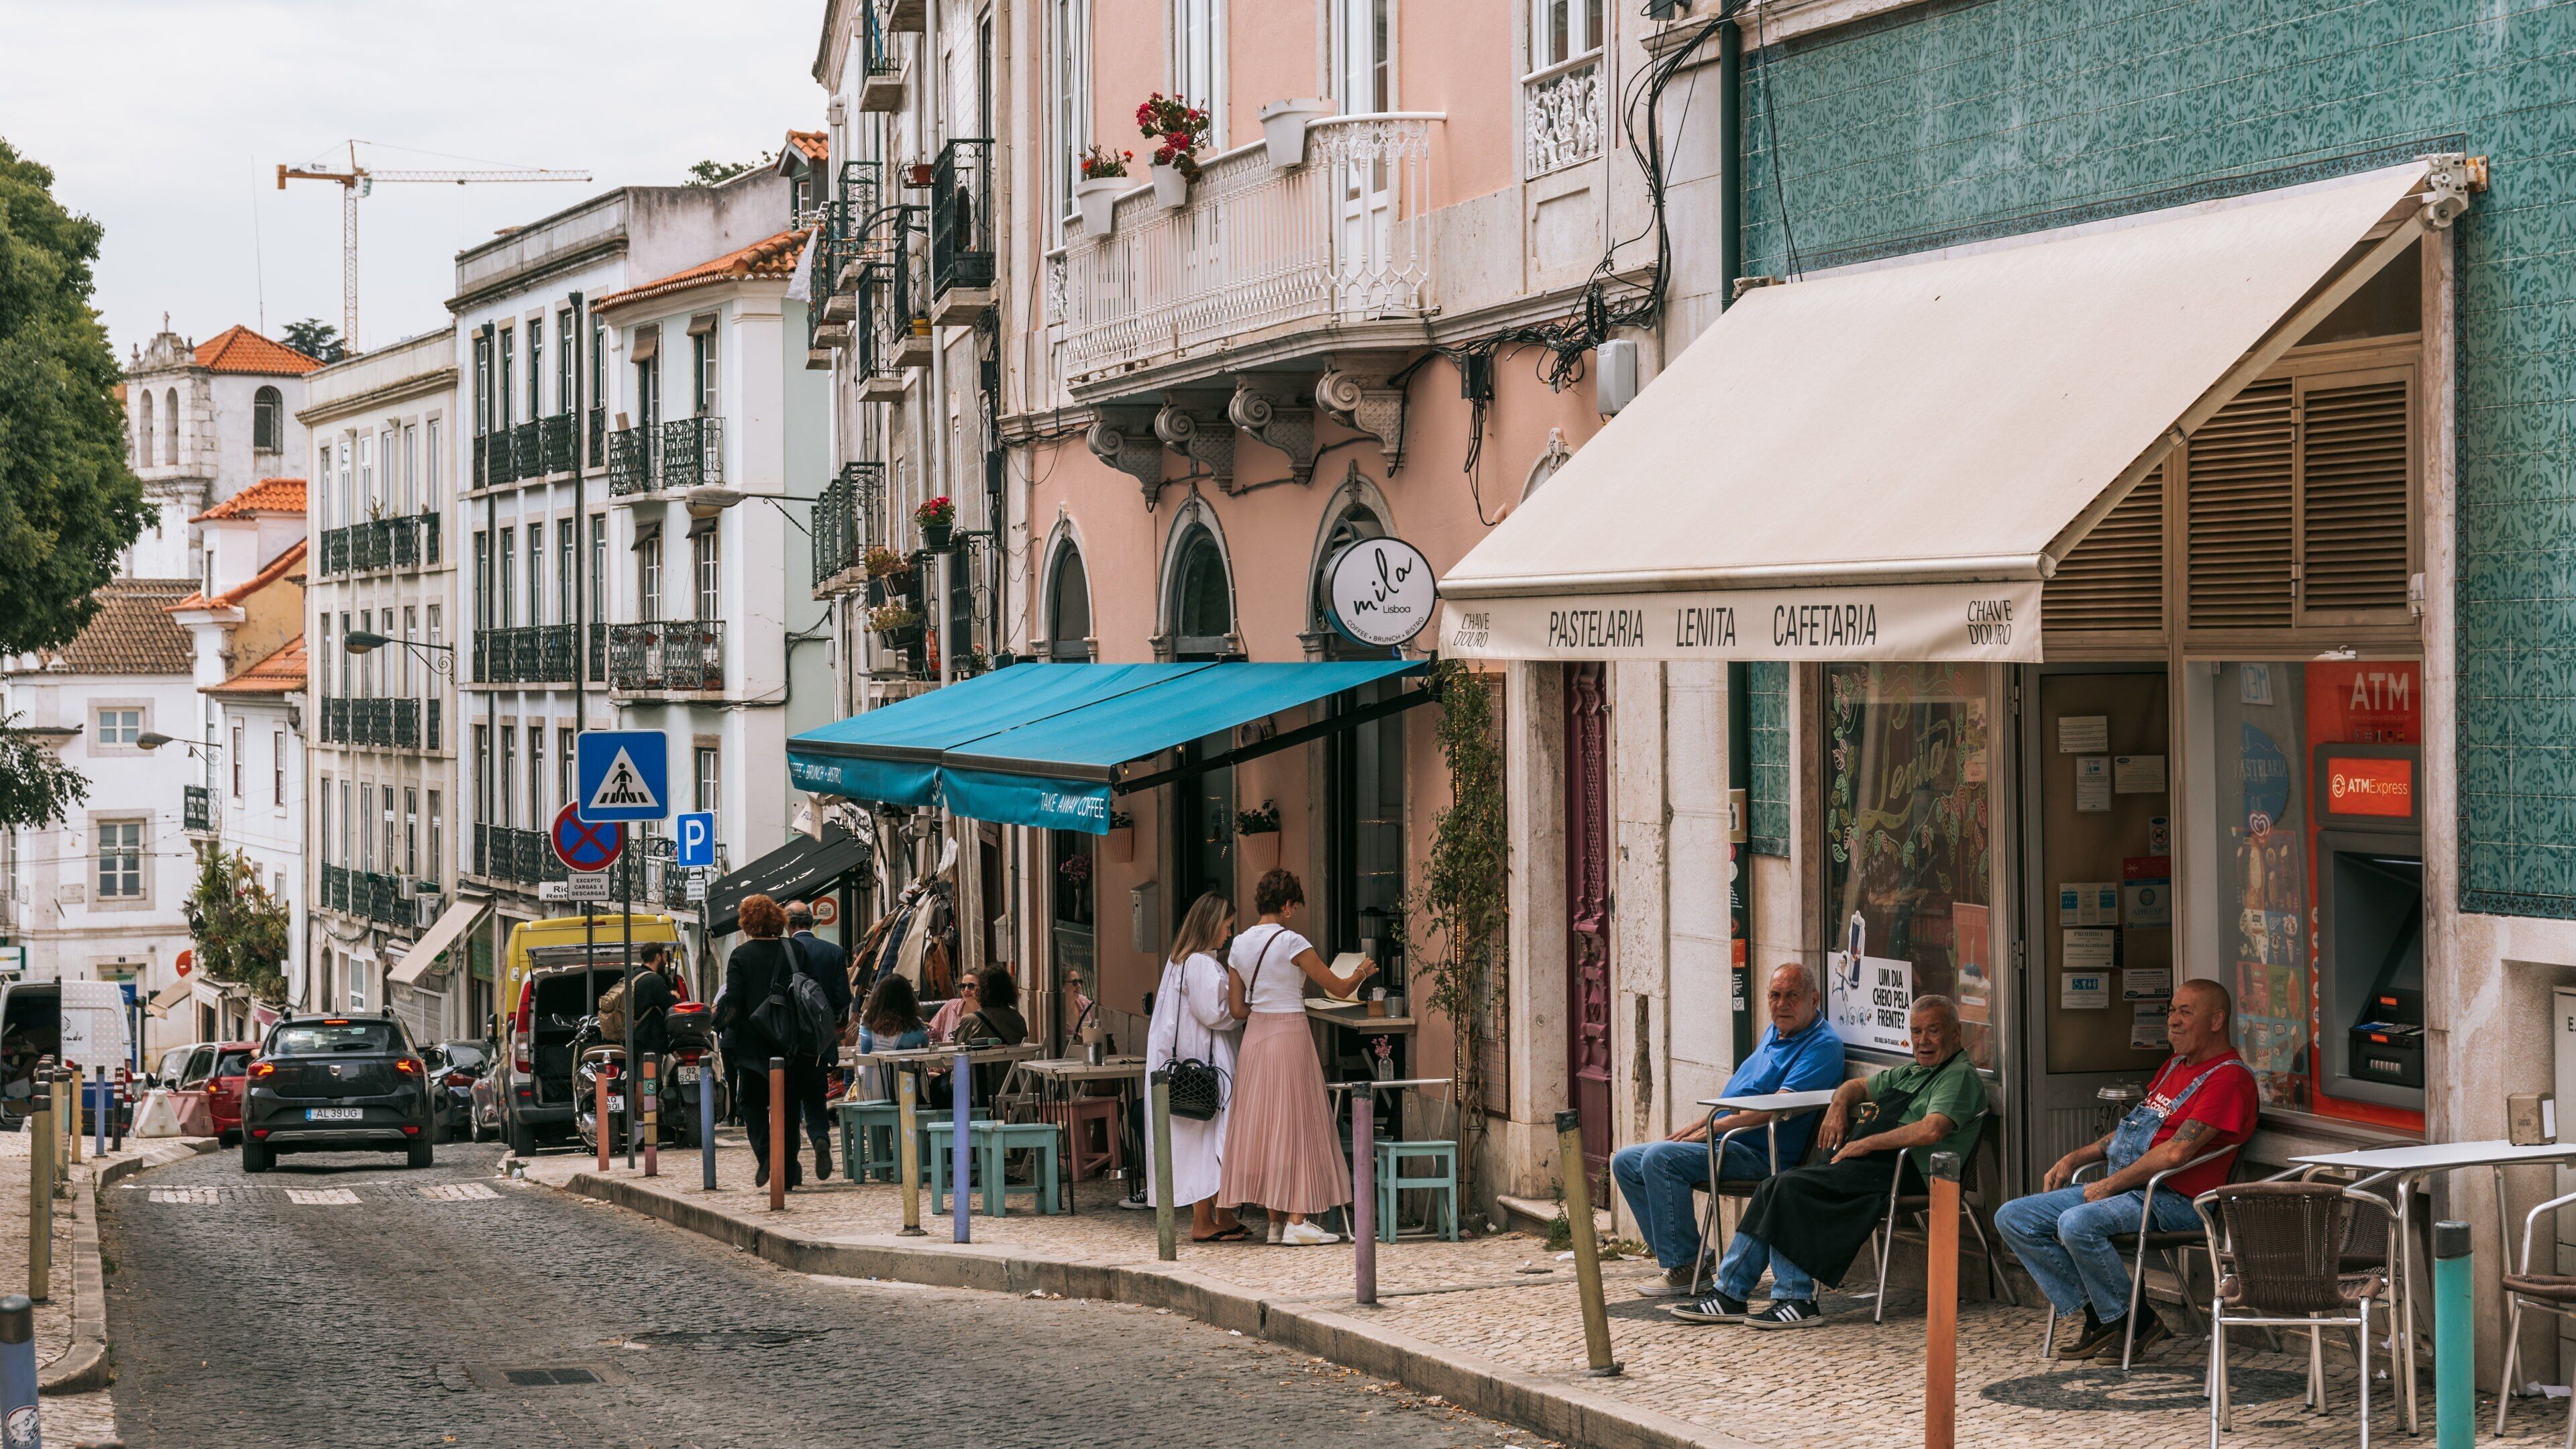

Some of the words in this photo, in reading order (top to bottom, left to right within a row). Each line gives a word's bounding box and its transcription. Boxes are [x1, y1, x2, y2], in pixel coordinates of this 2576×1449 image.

[1353, 547, 1412, 616] mila
[1383, 605, 1411, 614] Lisboa
[1967, 599, 2012, 623] CHAVE
[1346, 619, 1368, 639] COFFEE
[1373, 634, 1401, 643] BRUNCH
[1405, 616, 1424, 636] BISTRO
[1461, 612, 1490, 630] CHAVE
[1549, 609, 1644, 647] PASTELARIA
[1676, 606, 1735, 647] LENITA
[1773, 604, 1877, 647] CAFETARIA
[1453, 630, 1489, 648] D'OURO
[1967, 623, 2012, 645] D'OURO
[2349, 672, 2409, 711] ATM
[1859, 686, 1951, 832] Lenita
[805, 765, 825, 780] BRUNCH
[826, 767, 842, 784] BISTRO
[2347, 777, 2408, 797] ATMExpress
[1040, 792, 1057, 813] TAKE
[1057, 794, 1078, 816] AWAY
[1077, 795, 1105, 820] COFFEE
[686, 819, 705, 861] P
[1878, 967, 1890, 987] UM
[1891, 969, 1903, 989] DIA
[1872, 987, 1892, 1007] CHEIO
[1894, 989, 1910, 1010] PELA
[1877, 1008, 1905, 1030] FRENTE?
[316, 1109, 329, 1118] AL
[331, 1109, 342, 1118] 39
[343, 1109, 357, 1118] UG
